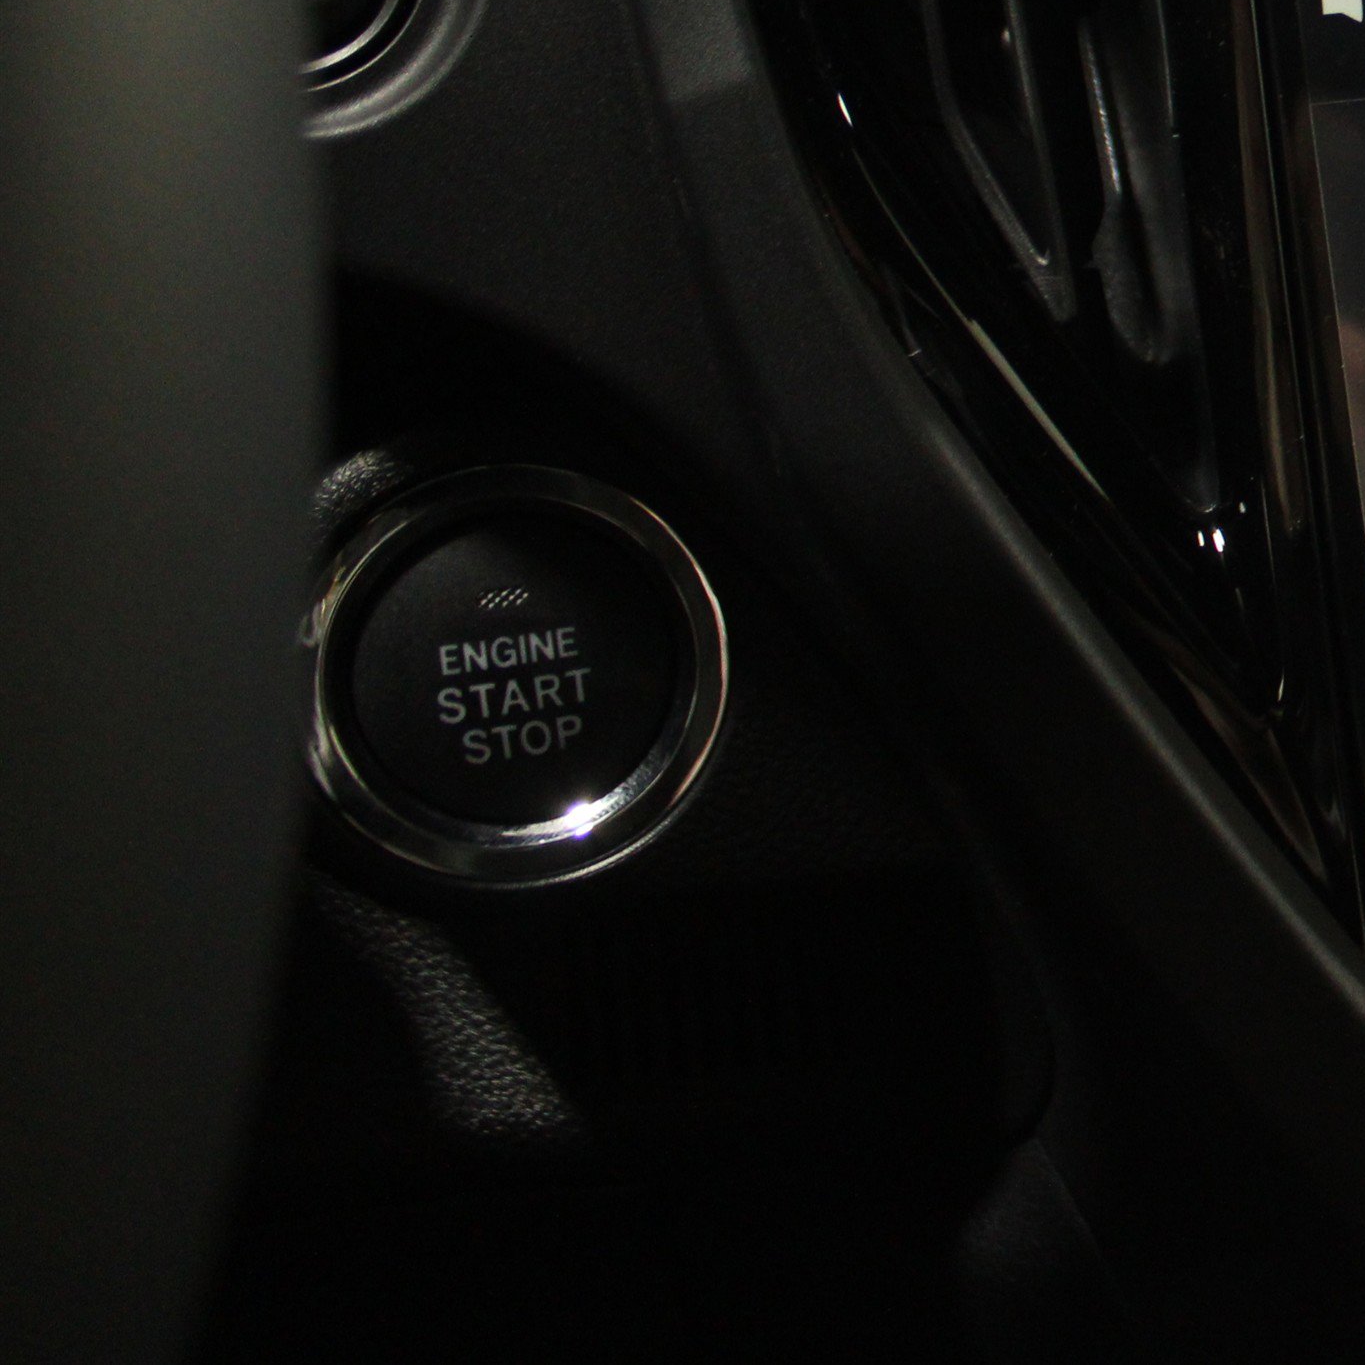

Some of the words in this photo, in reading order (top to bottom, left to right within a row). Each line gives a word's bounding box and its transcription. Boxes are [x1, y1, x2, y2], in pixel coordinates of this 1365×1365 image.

[439, 627, 578, 676] ENGINE
[437, 668, 591, 724] START
[463, 715, 583, 765] STOP
